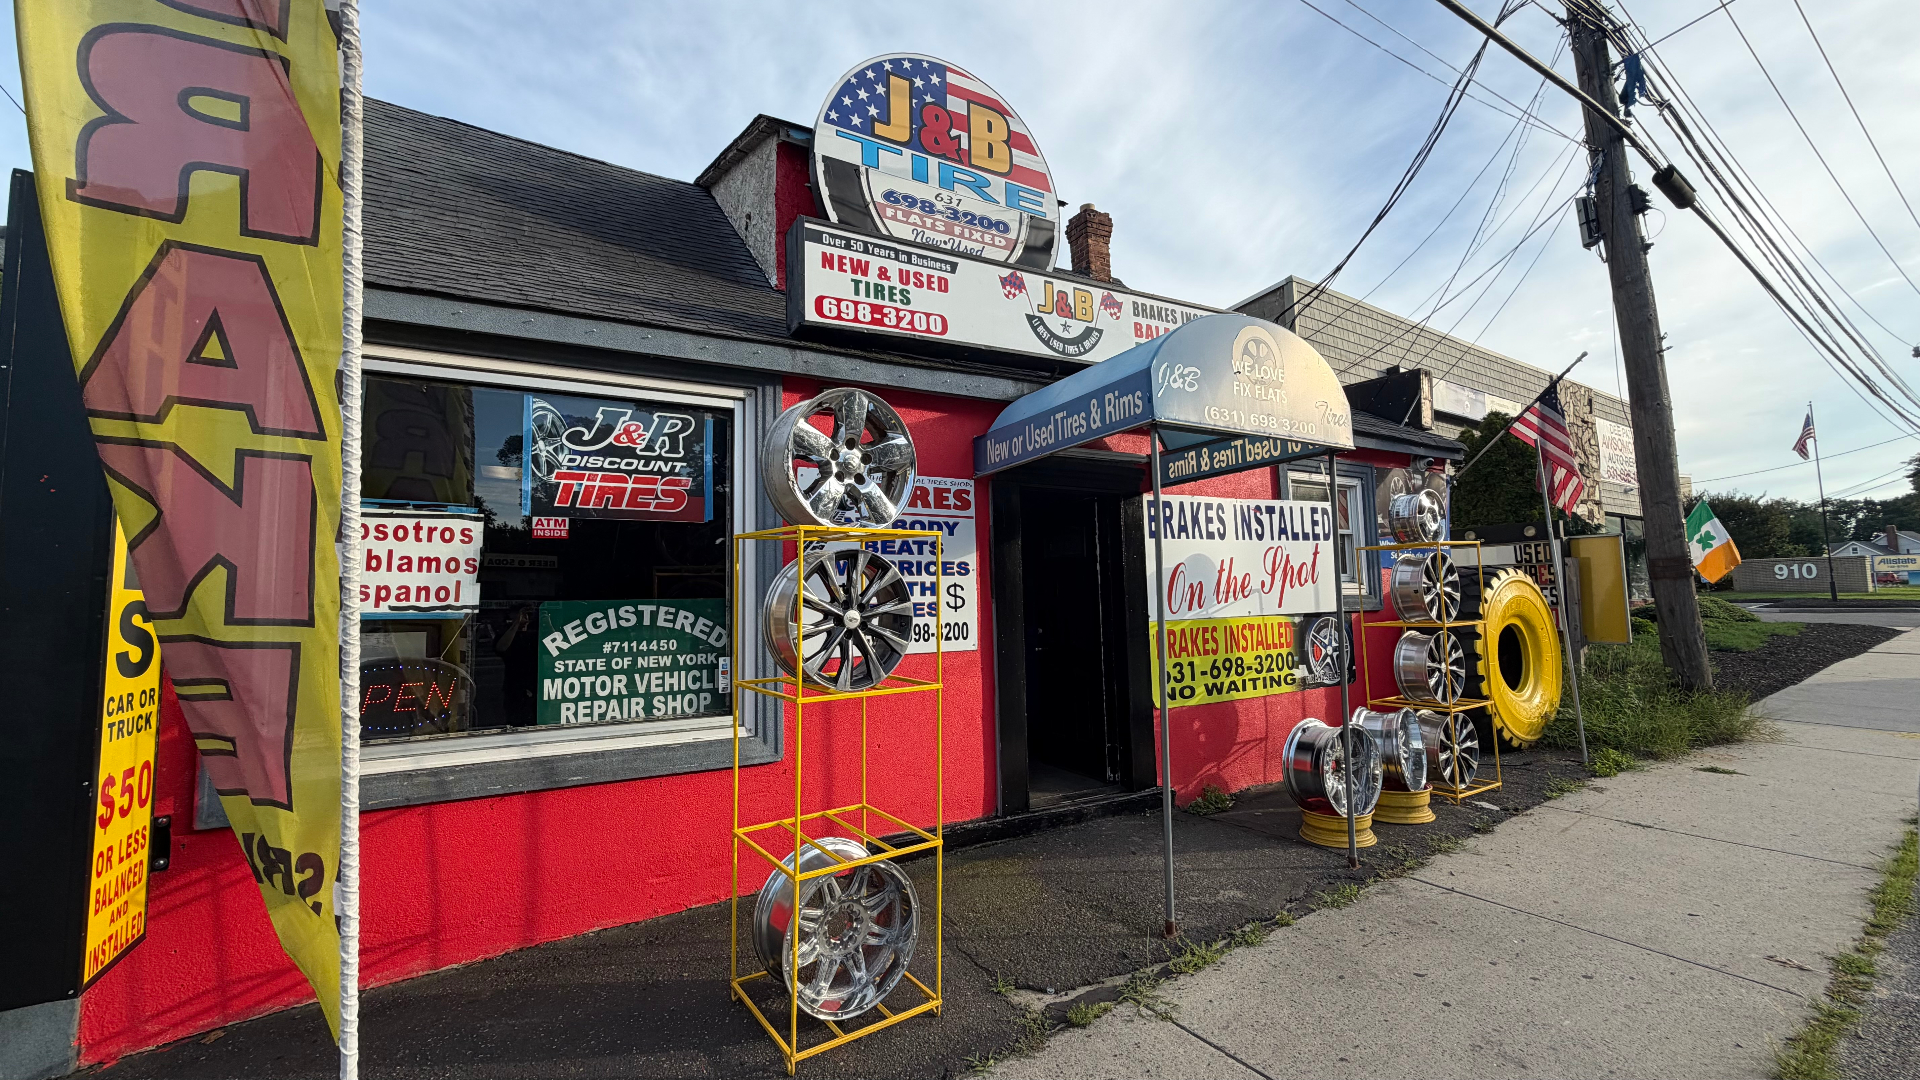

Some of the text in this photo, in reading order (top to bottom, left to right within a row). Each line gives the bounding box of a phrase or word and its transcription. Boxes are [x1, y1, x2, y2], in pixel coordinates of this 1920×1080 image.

[871, 71, 1014, 177] J&B
[836, 129, 1048, 217] TIRE
[881, 189, 1011, 235] 698-3200
[934, 192, 963, 207] 631
[886, 209, 1007, 248] FLATS FIXED
[822, 234, 951, 272] Over 50 Years in Business
[821, 251, 949, 294] NEW & USED
[851, 278, 911, 306] TIRES
[1037, 280, 1094, 324] J&B
[822, 298, 943, 334] 698-3200
[1132, 300, 1178, 325] BRAKES
[1036, 325, 1051, 342] BEST
[1049, 337, 1064, 351] USED
[1064, 344, 1080, 355] TIRES
[1079, 345, 1085, 353] &
[1083, 330, 1100, 350] BRAKES
[1157, 361, 1201, 398] J&B
[1231, 360, 1285, 383] WE LOVE
[1233, 381, 1288, 404] FIX FLATS
[986, 390, 1143, 465] New or Used Tires & Rims
[1204, 405, 1245, 427] (631)
[562, 406, 695, 458] J&R
[562, 454, 687, 473] DISCOUNT
[908, 485, 972, 512] RES
[927, 479, 948, 487] TIRES
[361, 520, 474, 545] osotros
[533, 529, 568, 537] INSIDE
[534, 518, 567, 528] ATM
[1233, 503, 1332, 542] INSTALLED
[365, 549, 478, 575] blamos
[865, 539, 945, 556] BEATS
[1513, 543, 1553, 564] USED
[1877, 557, 1918, 566] Allstate
[1167, 542, 1320, 615] On the Spot
[1774, 562, 1818, 580] 910
[360, 580, 462, 608] spanol
[946, 582, 966, 613] $
[542, 604, 727, 658] REGISTERED
[602, 639, 678, 654] #7114450
[1224, 621, 1294, 654] INSTALLED
[554, 652, 718, 673] STATE OF NEW YORK
[360, 680, 457, 715] PEN
[543, 674, 628, 701] MOTOR
[634, 669, 720, 694] VEHICL
[1204, 671, 1297, 697] WAITING
[106, 687, 157, 718] CAR OR
[560, 692, 713, 725] REPAIR SHOP
[107, 710, 153, 743] TRUCK
[98, 759, 152, 835] $50
[95, 829, 148, 879] OR LESS
[94, 859, 144, 917] BALANCED
[108, 902, 129, 928] AND
[87, 915, 144, 979] INSTALLED
